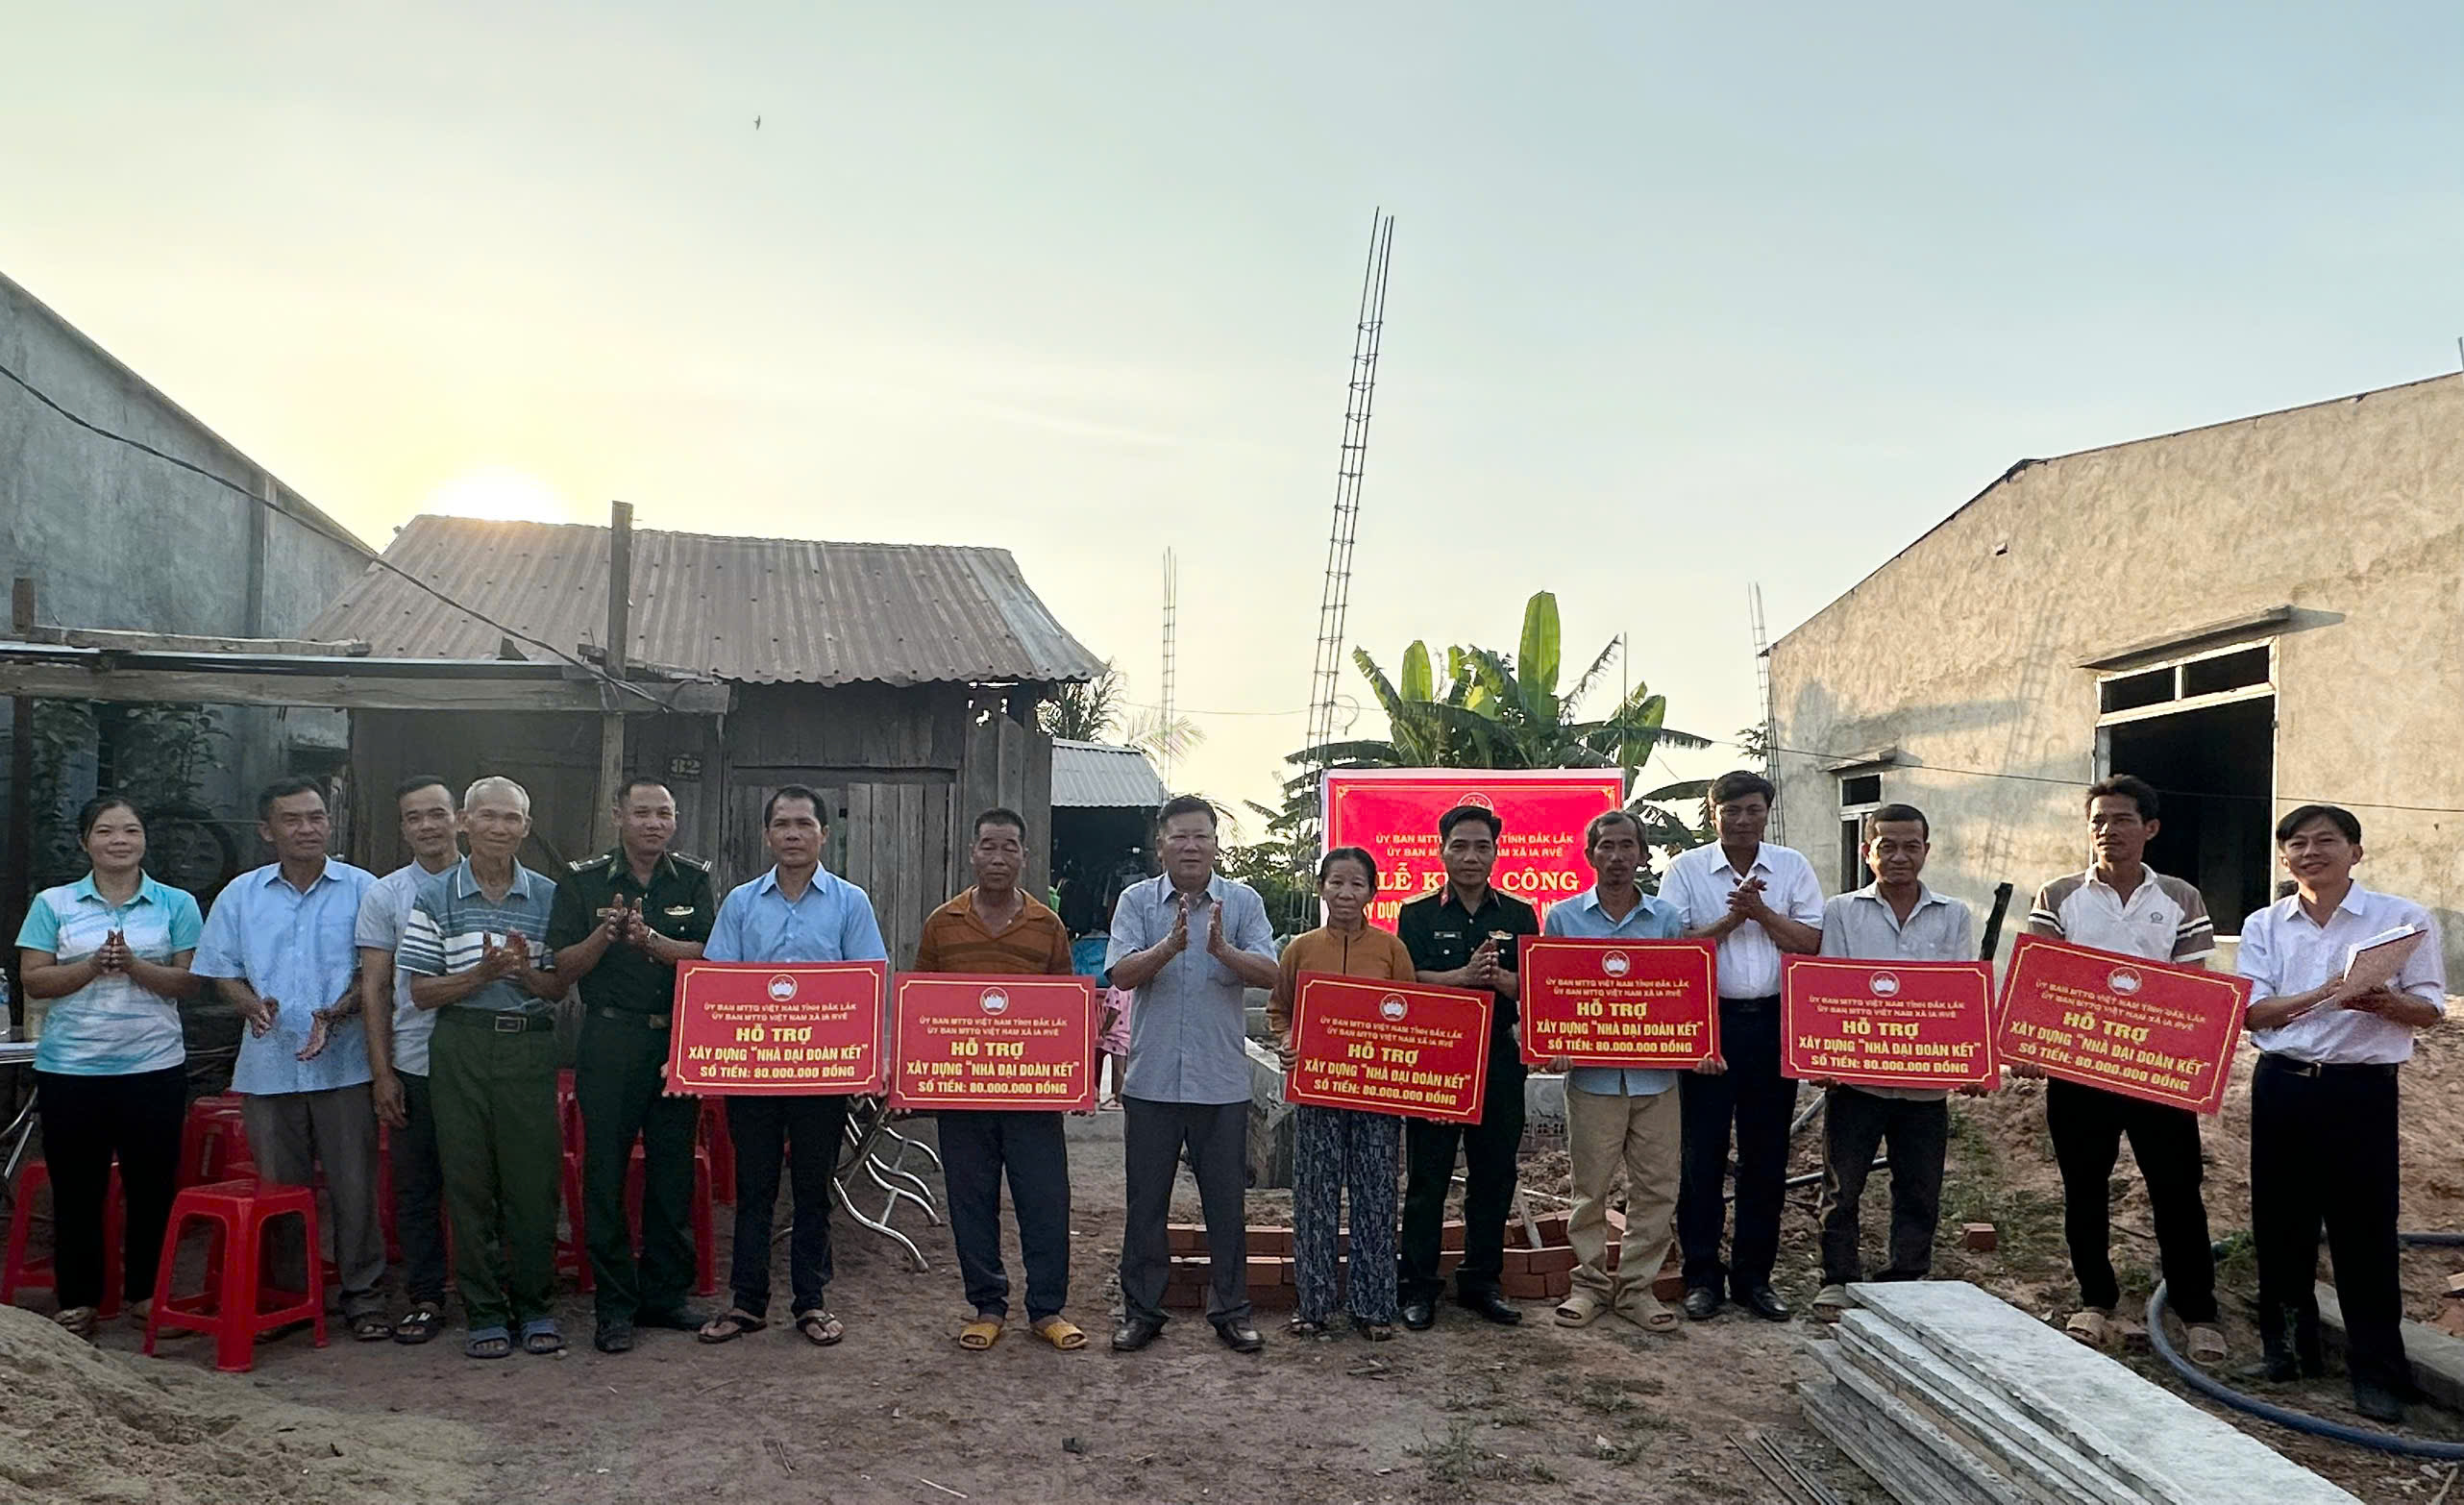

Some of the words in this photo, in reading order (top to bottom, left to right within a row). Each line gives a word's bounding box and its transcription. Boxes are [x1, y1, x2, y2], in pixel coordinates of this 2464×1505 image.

[1393, 834, 1415, 844] BAN
[1377, 862, 1412, 891] LỄ
[1502, 867, 1579, 891] CÔNG
[1576, 998, 1603, 1016] HỖ
[1609, 1001, 1647, 1020] TRỢ
[735, 1023, 765, 1041] HỖ
[770, 1026, 812, 1044] TRỢ
[1536, 1019, 1557, 1033] XÂY
[1560, 1021, 1589, 1036] DỰNG
[1841, 1016, 1871, 1034] HỖ
[1877, 1021, 1919, 1040] TRỢ
[2009, 1018, 2036, 1037] XÂY
[2099, 1019, 2150, 1047] TRỢ
[688, 1046, 712, 1060] XÂY
[714, 1047, 747, 1063] DỰNG
[950, 1036, 978, 1055] HỖ
[984, 1041, 1024, 1059] TRỢ
[1347, 1038, 1375, 1060] HỖ
[1379, 1046, 1418, 1068] TRỢ
[1547, 1036, 1562, 1049] SỐ
[1596, 1040, 1657, 1052] 80.000.000
[1799, 1035, 1820, 1049] XÂY
[1824, 1038, 1855, 1054] DỰNG
[700, 1064, 716, 1077] SỐ
[753, 1067, 819, 1077] 80.000.000
[906, 1059, 928, 1074] XÂY
[931, 1061, 962, 1077] DỰNG
[1304, 1056, 1326, 1073] XÂY
[1327, 1060, 1358, 1079] DỰNG
[1811, 1052, 1827, 1066] SỐ
[1863, 1058, 1930, 1073] 80.000.000
[918, 1078, 933, 1092] SỐ
[969, 1082, 1032, 1094] 80.000.000
[1313, 1075, 1329, 1090] SỐ
[1362, 1084, 1422, 1101] 80.000.000
